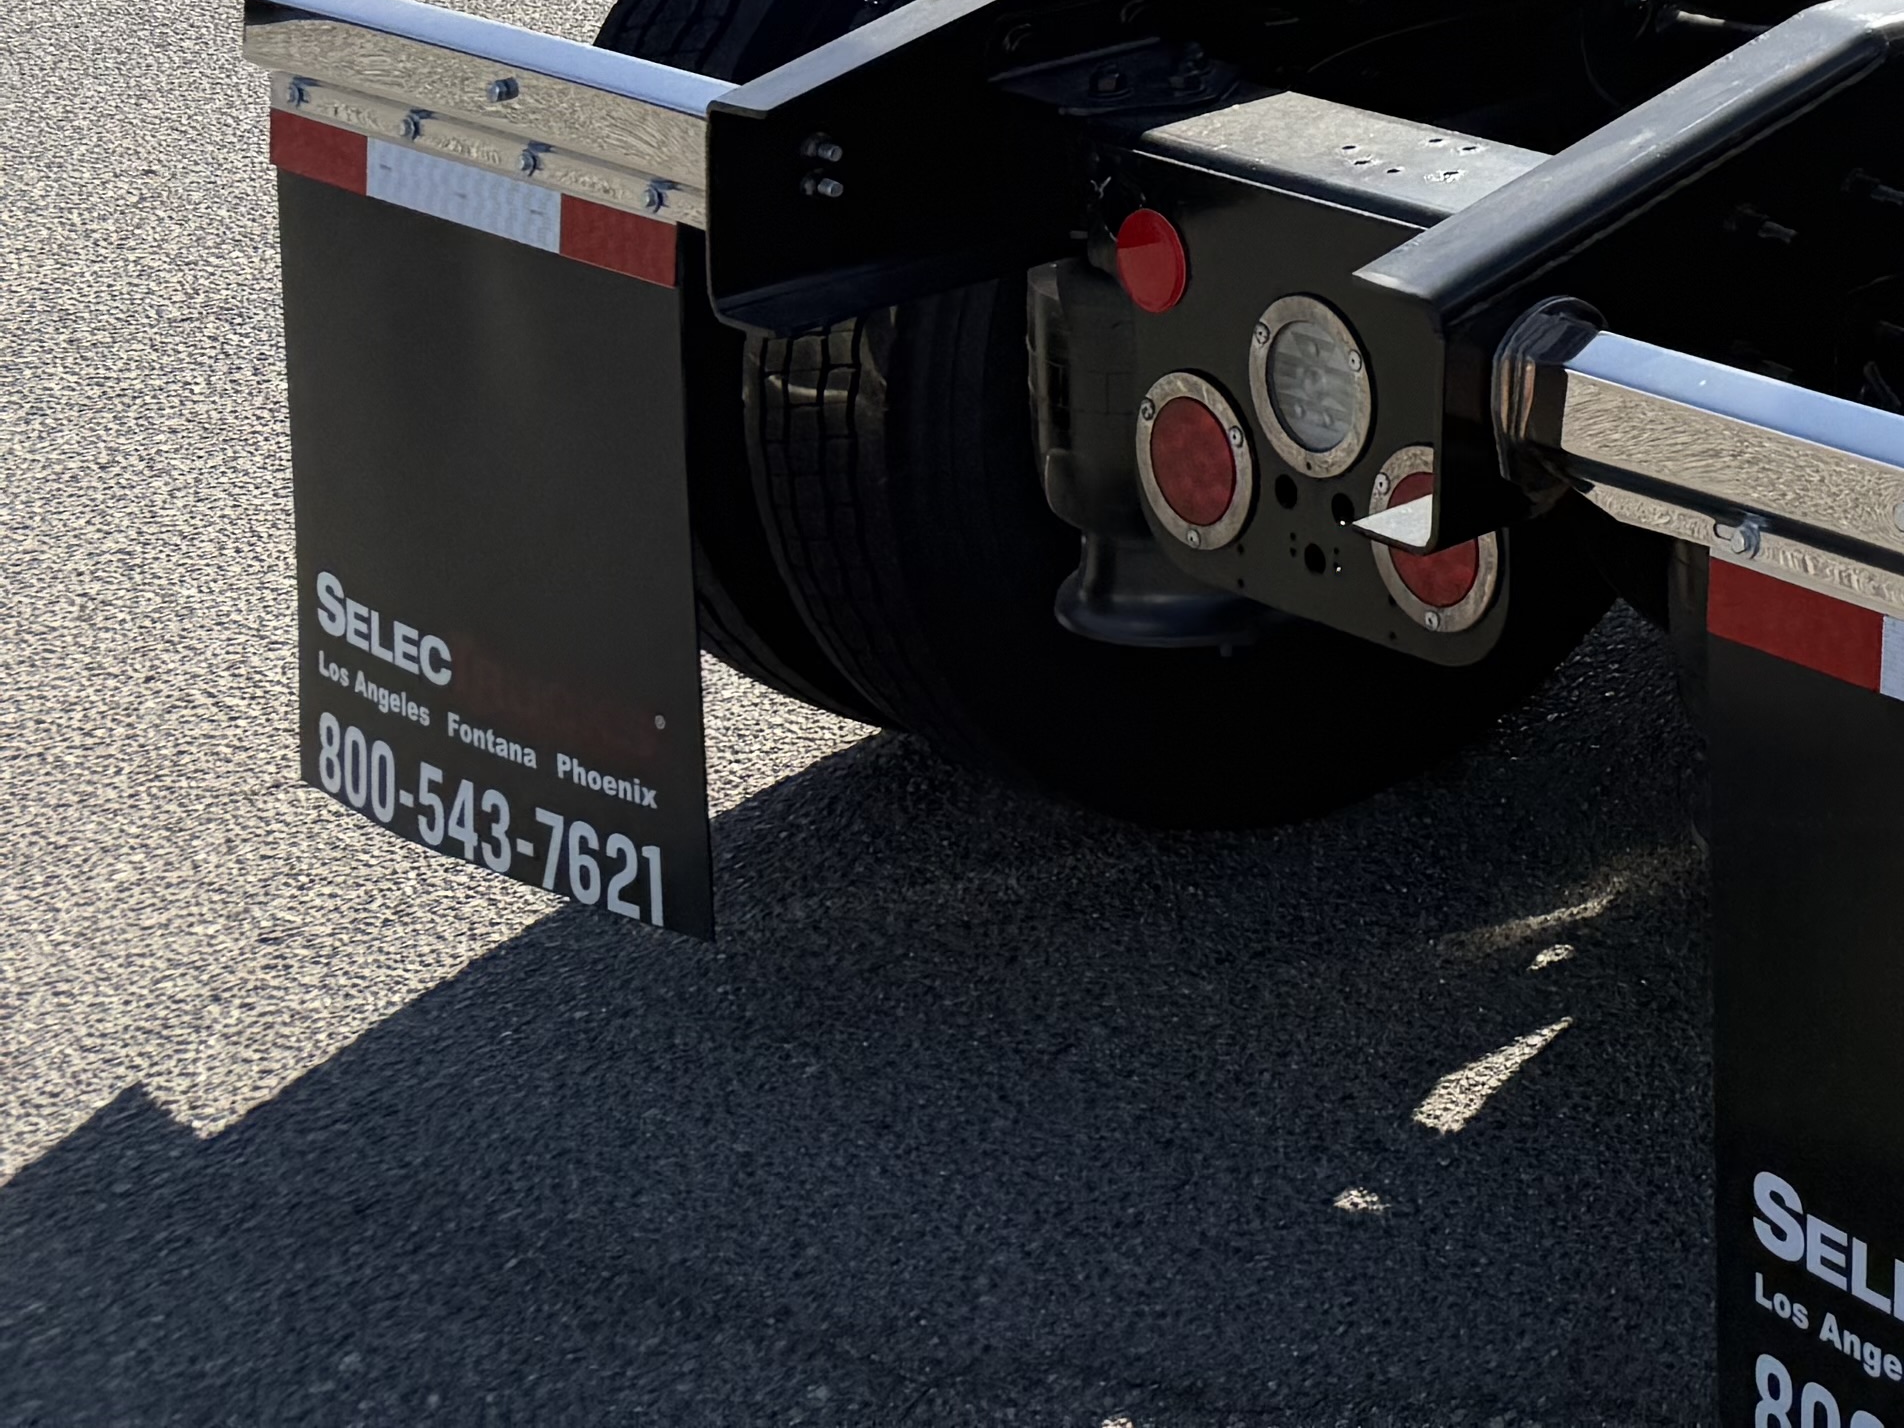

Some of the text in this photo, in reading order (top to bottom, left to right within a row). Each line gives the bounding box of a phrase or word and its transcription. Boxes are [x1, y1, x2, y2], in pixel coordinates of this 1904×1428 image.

[318, 650, 658, 809] Los Angeles Fontana Phoenix
[318, 712, 665, 927] 800-543-7621
[1755, 1272, 1809, 1330] Los
